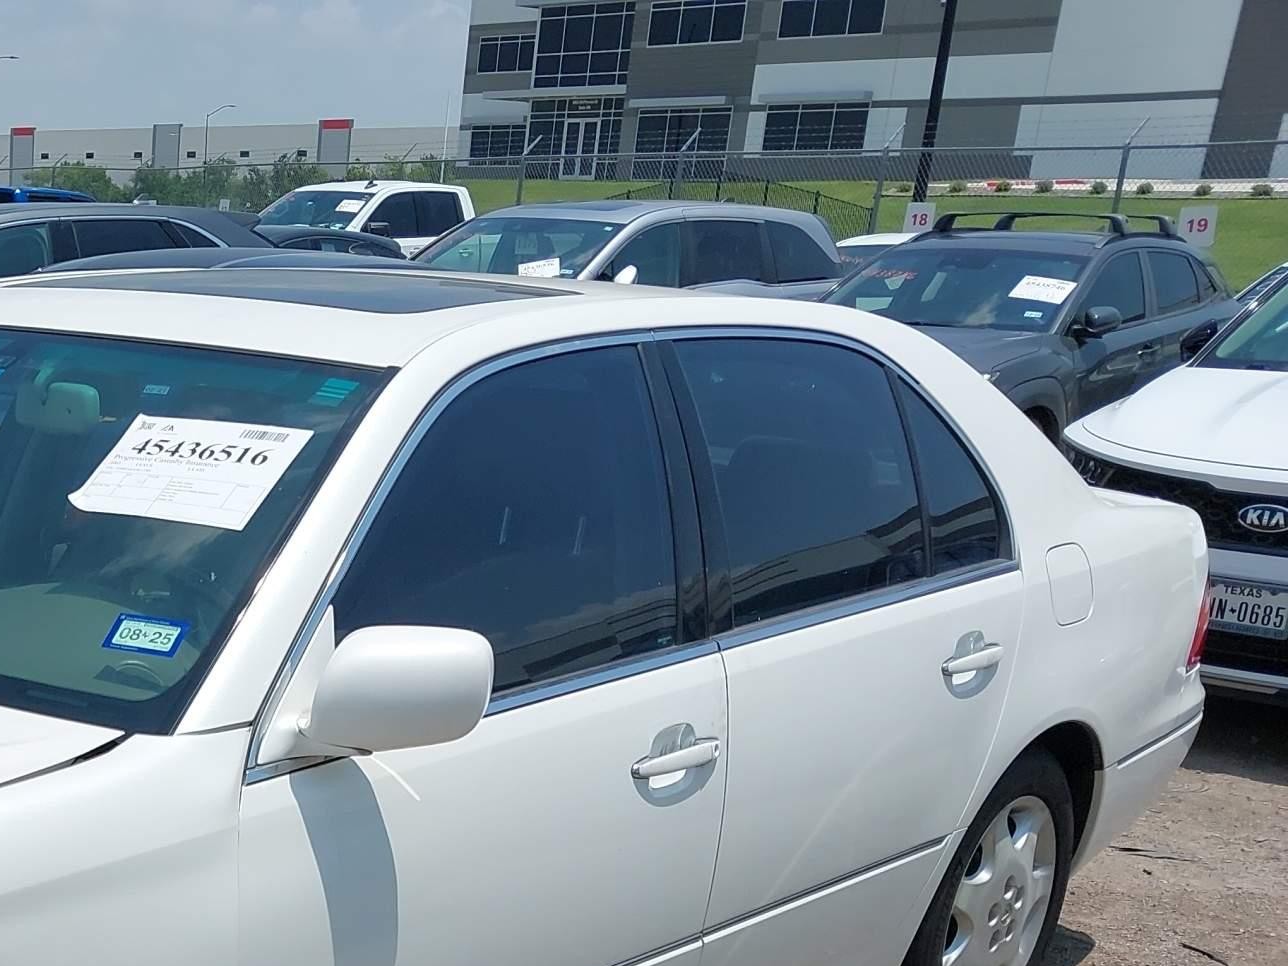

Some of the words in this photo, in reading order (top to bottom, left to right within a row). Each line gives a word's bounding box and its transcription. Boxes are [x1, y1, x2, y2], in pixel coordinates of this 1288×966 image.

[912, 213, 928, 226] 18
[1187, 218, 1209, 233] 19
[132, 438, 276, 466] 45436516
[1246, 509, 1286, 528] KIA
[1224, 585, 1263, 599] TEXAS
